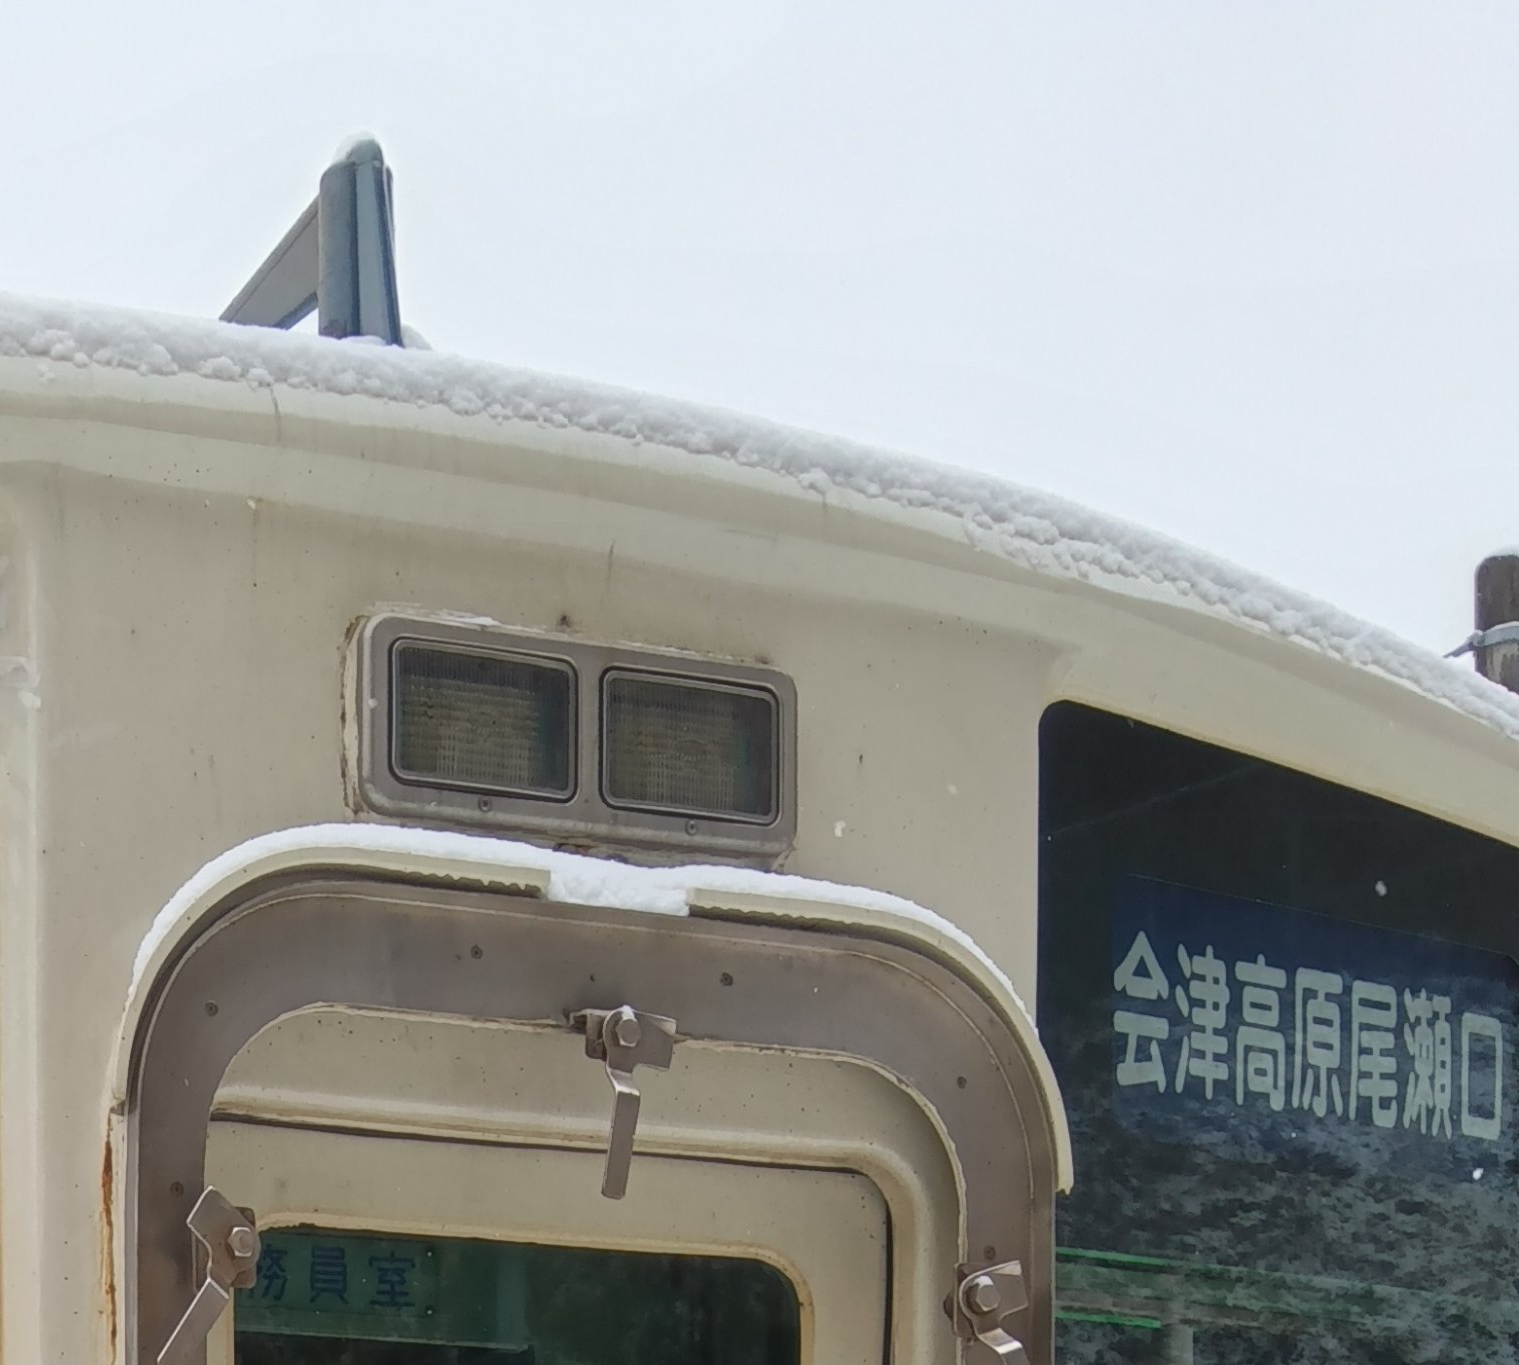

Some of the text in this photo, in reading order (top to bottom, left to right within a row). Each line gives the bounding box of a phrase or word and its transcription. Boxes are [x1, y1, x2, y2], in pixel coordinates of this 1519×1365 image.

[1112, 930, 1504, 1141] 会津高原尾瀬口
